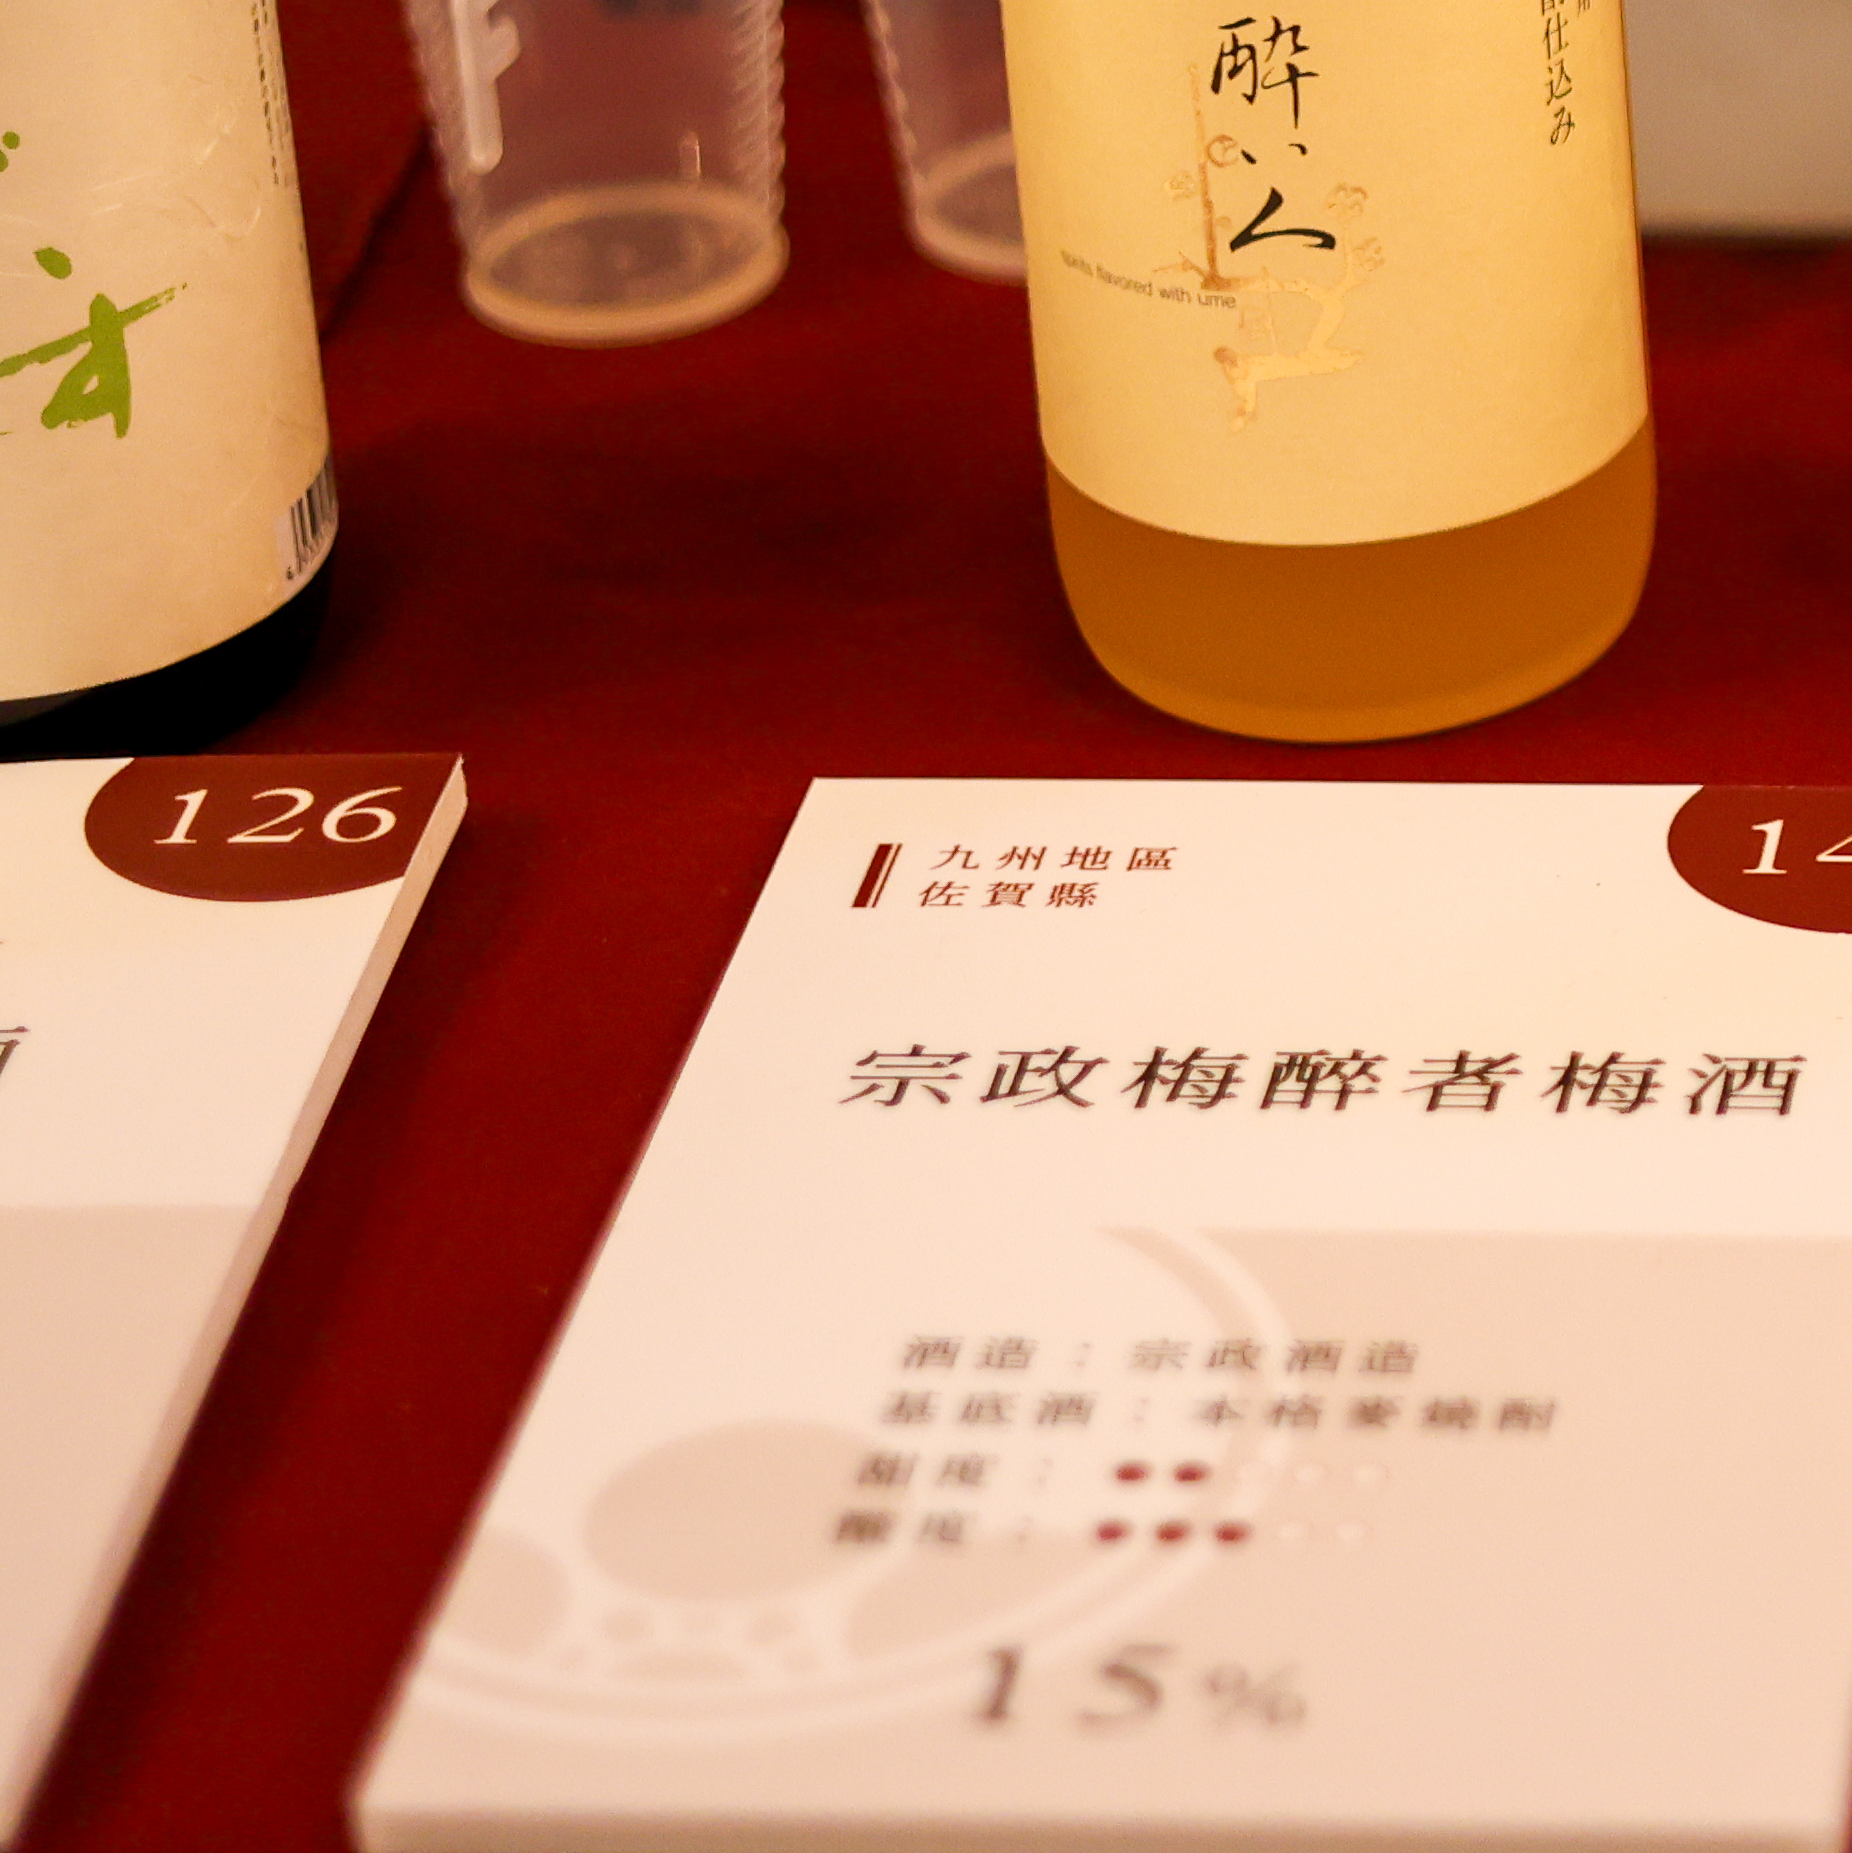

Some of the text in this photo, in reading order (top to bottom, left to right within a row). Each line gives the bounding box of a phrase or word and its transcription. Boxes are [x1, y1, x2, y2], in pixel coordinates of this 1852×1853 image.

[1159, 287, 1192, 304] with
[1197, 293, 1237, 308] ume
[153, 786, 402, 845] 126
[930, 844, 1179, 873] 九州地區
[916, 880, 1099, 911] 佐賀縣
[835, 1045, 1810, 1116] 宗政梅醉者梅酒
[971, 1643, 1308, 1727] 15%
